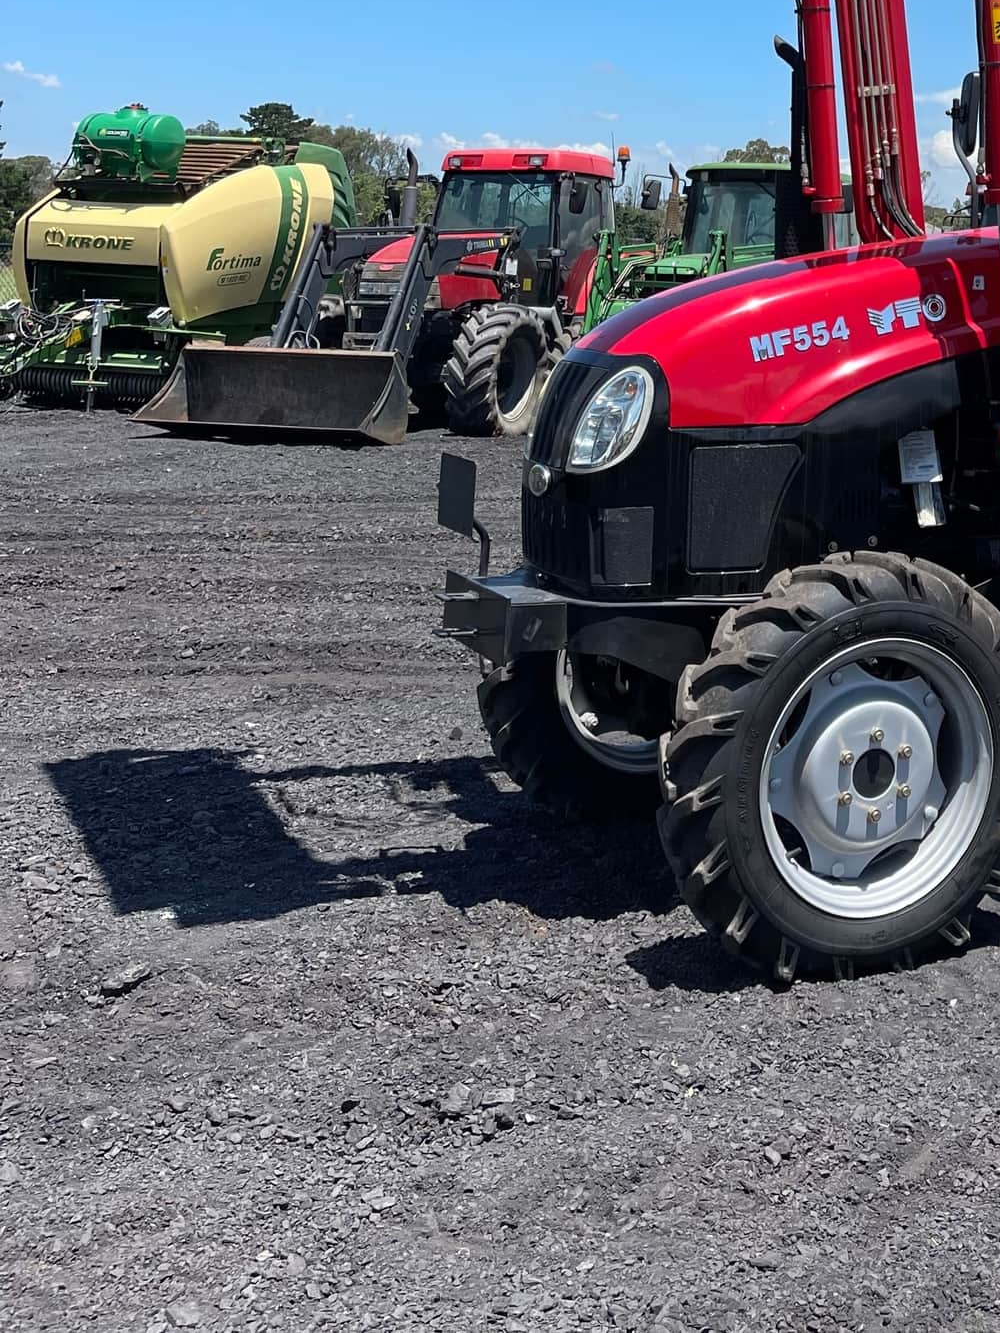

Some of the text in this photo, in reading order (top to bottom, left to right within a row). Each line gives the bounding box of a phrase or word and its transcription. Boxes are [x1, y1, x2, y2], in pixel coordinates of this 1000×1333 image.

[65, 234, 135, 250] KRONE
[283, 177, 303, 266] KRONE
[206, 247, 262, 271] Fortima
[867, 294, 946, 335] YTO
[750, 316, 850, 362] MF554
